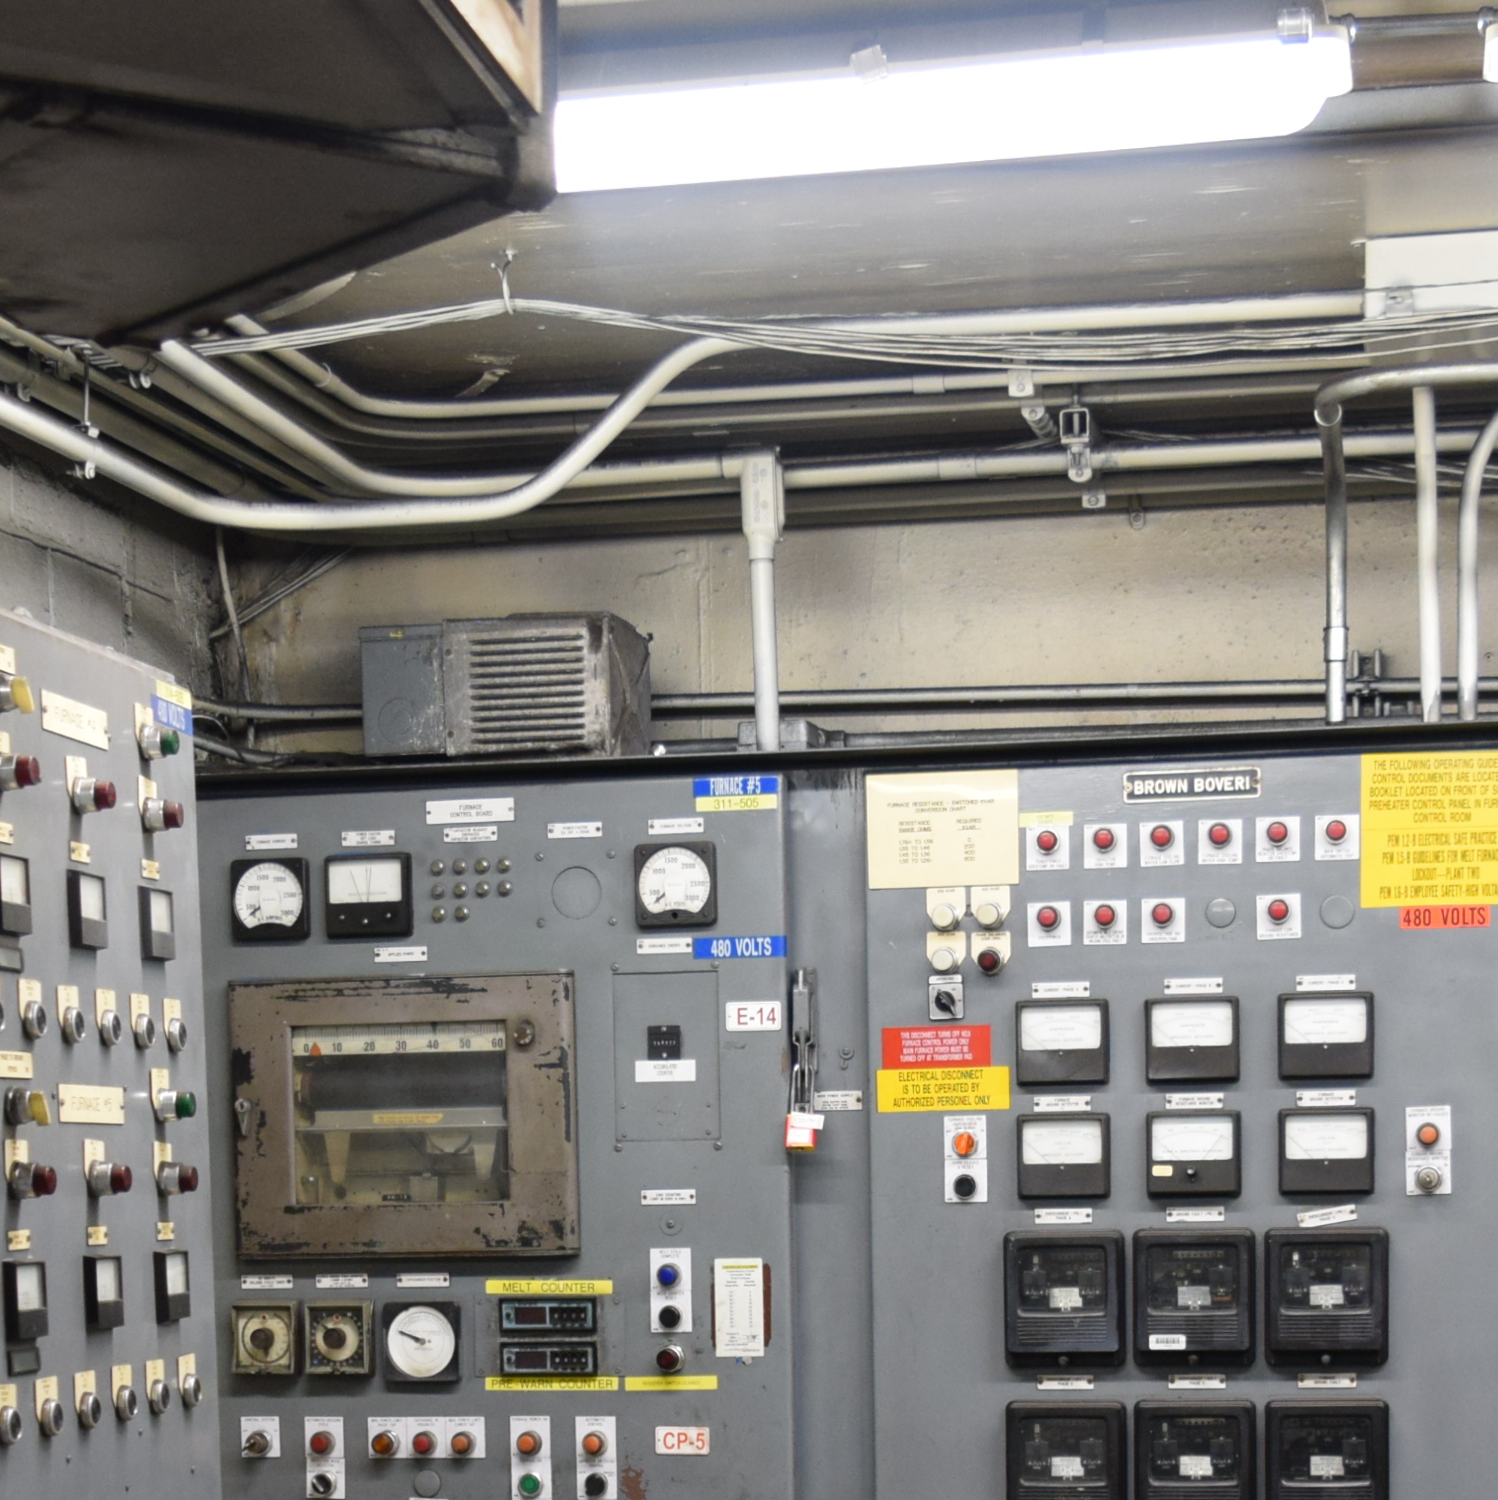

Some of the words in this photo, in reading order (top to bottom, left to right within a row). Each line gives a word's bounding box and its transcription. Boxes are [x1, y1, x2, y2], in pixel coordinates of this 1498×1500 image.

[1374, 760, 1387, 771] THE
[1390, 759, 1431, 770] FOLLOWING
[1434, 758, 1474, 769] OPERATING
[1372, 773, 1405, 784] CONTROL
[1408, 772, 1452, 783] DOCUMENTS
[1456, 771, 1470, 782] ARE
[710, 777, 743, 796] FURNACE
[747, 777, 761, 794] #5
[1134, 779, 1188, 795] BROWN
[1194, 776, 1250, 792] BOVERI
[1370, 785, 1402, 797] BOOKLET
[1406, 785, 1437, 797] LOCATED
[1440, 785, 1451, 796] ON
[1453, 784, 1477, 796] FRONT
[1480, 784, 1489, 795] OF
[713, 798, 759, 809] 311-505
[1369, 799, 1410, 811] PREHEATER
[1412, 799, 1446, 810] CONTROL
[1450, 799, 1471, 809] PANEL
[1474, 798, 1482, 809] IN
[475, 810, 493, 818] BOARD
[1413, 812, 1447, 823] CONTROL
[1450, 811, 1472, 822] ROOM
[1418, 832, 1451, 846] ELECTRICAL
[1454, 831, 1469, 845] SAFE
[1470, 830, 1497, 845] PRACTICE
[1413, 850, 1445, 864] GUIDELINES
[1447, 850, 1458, 863] FOR
[1467, 866, 1480, 880] TWO
[1410, 884, 1439, 898] EMPLOYEE
[1403, 908, 1431, 926] 480
[1441, 907, 1486, 926] VOLTS
[710, 940, 731, 957] 480
[735, 937, 772, 957] VOLTS
[736, 1007, 777, 1025] E-14
[304, 1043, 310, 1054] 0
[332, 1042, 343, 1052] 10
[364, 1041, 376, 1051] 20
[395, 1040, 407, 1051] 30
[427, 1039, 439, 1050] 40
[459, 1038, 471, 1049] 50
[491, 1037, 503, 1048] 60
[898, 1071, 939, 1082] ELECTRICAL
[941, 1069, 984, 1081] DISCONNECT
[902, 1084, 909, 1095] IS
[912, 1083, 921, 1094] TO
[922, 1083, 932, 1094] BE
[934, 1082, 969, 1094] OPERATED
[971, 1082, 980, 1093] BY
[71, 1095, 101, 1111] FURNACE
[893, 1096, 935, 1107] AUTHORIZED
[937, 1095, 972, 1106] PERSONEL
[974, 1095, 991, 1105] ONLY
[502, 1282, 532, 1293] MELT
[541, 1282, 595, 1293] COUNTER
[491, 1378, 553, 1389] PRE-WARN
[559, 1378, 613, 1389] COUNTER
[663, 1432, 705, 1450] CP-5
